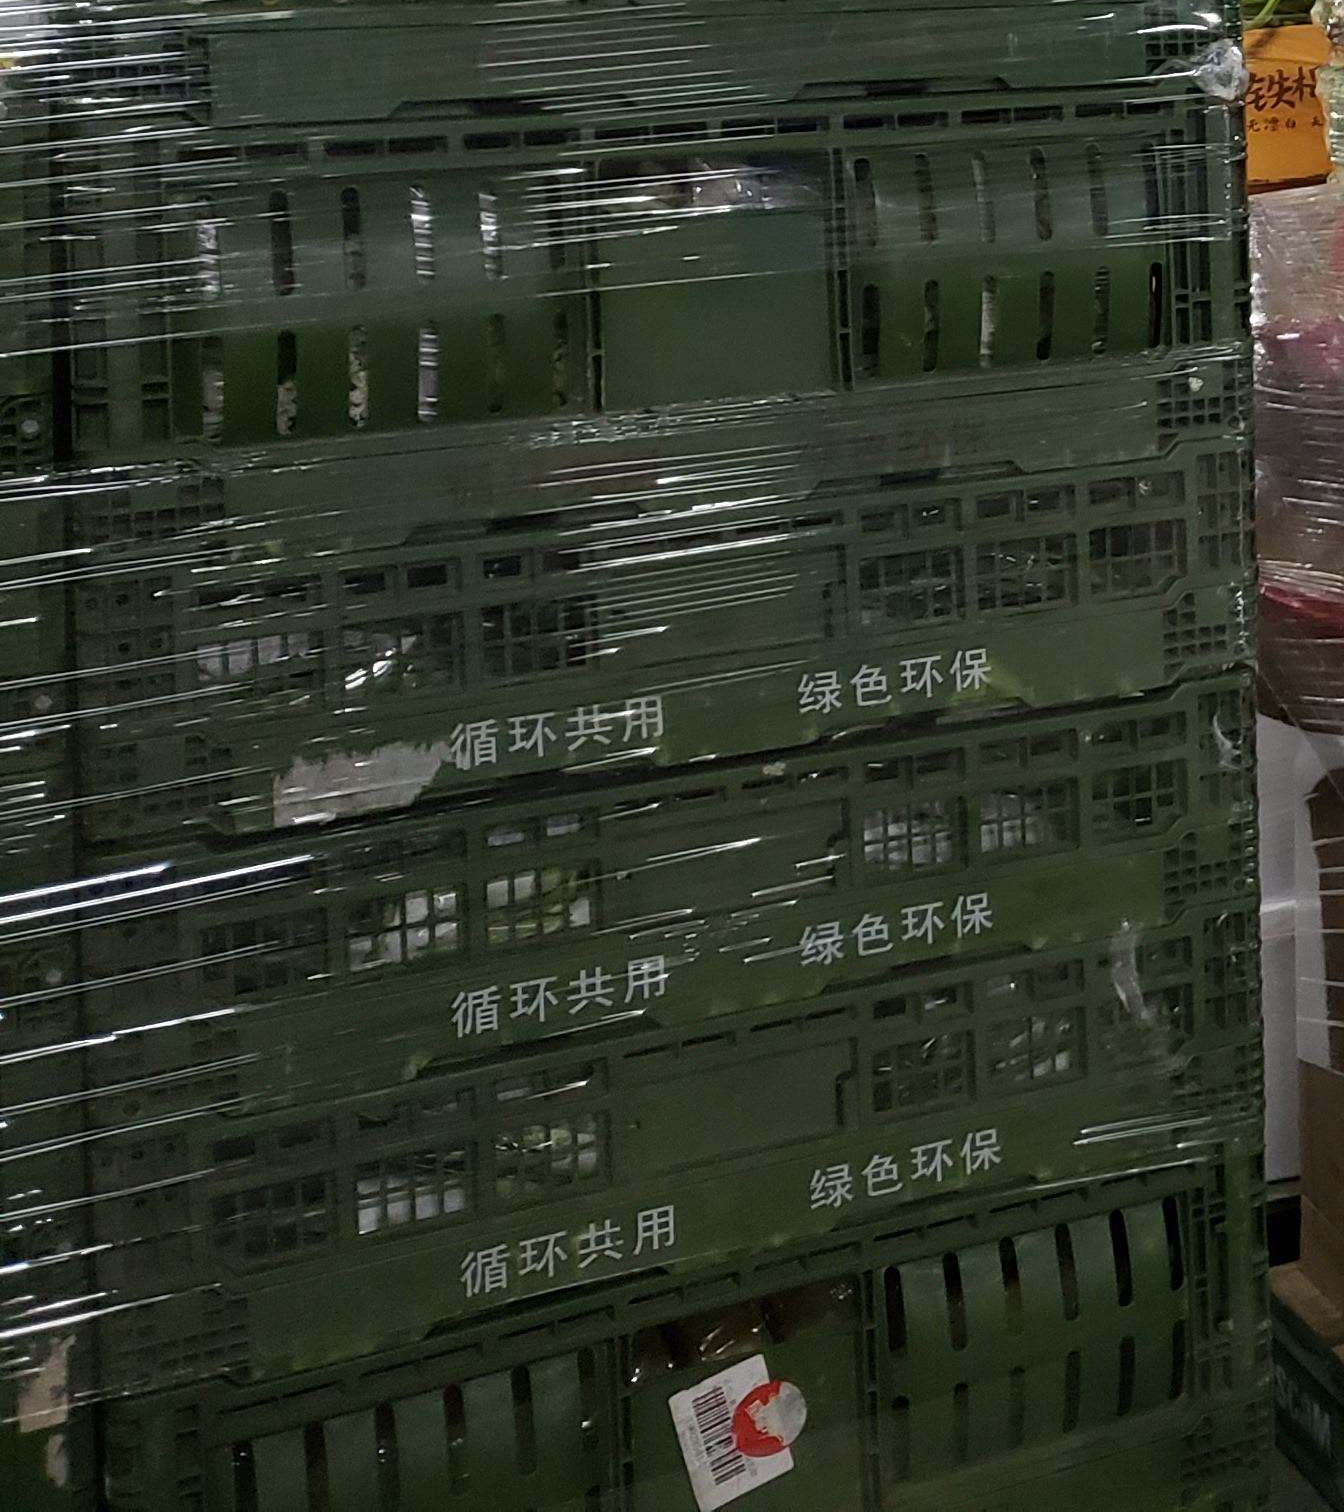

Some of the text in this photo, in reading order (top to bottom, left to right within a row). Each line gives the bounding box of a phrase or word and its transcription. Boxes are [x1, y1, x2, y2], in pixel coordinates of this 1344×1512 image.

[451, 647, 993, 770] 循环共用 绿色环保
[451, 892, 994, 1038] 循环共用 绿色环保
[459, 1128, 1002, 1297] 循环共用 绿色环保
